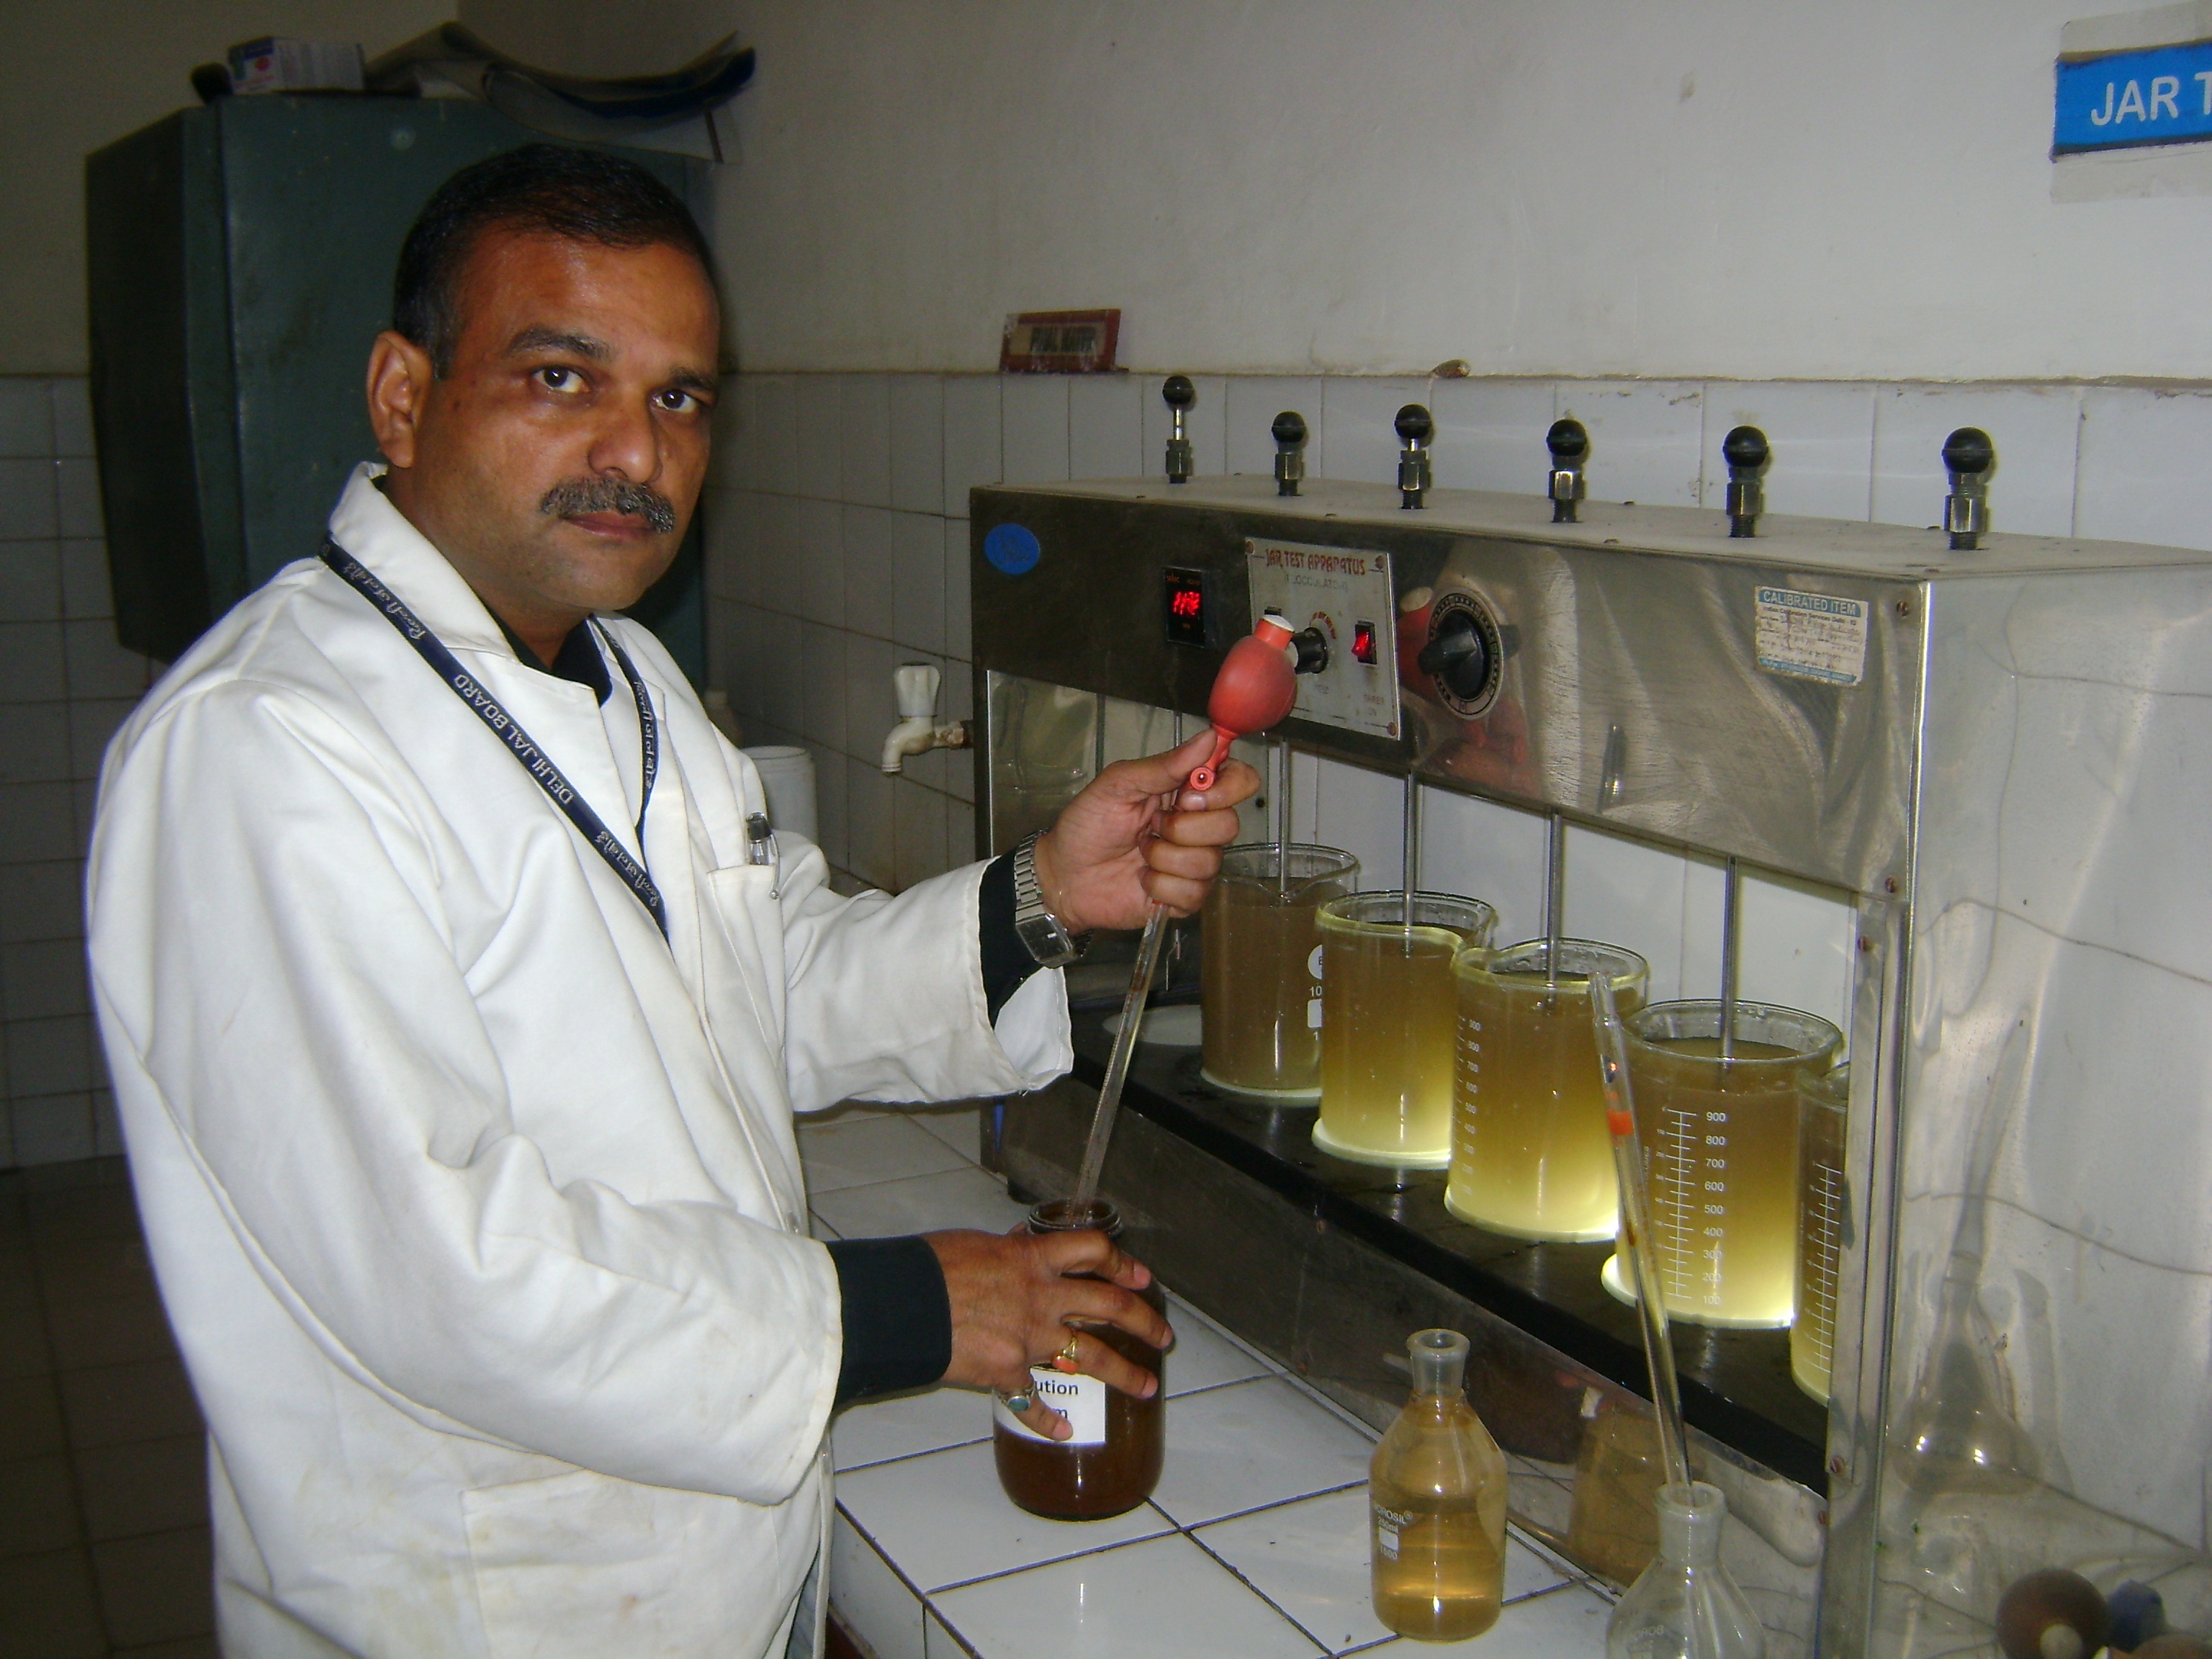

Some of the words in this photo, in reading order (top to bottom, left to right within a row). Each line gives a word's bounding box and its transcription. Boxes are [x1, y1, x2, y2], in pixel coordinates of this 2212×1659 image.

[2090, 76, 2180, 126] JAR
[1284, 550, 1305, 568] TEST
[1308, 554, 1365, 576] APPARATUS
[1763, 590, 1827, 611] CALIBRATED
[1831, 601, 1856, 616] ITEM
[454, 673, 510, 730] BOARD
[504, 724, 539, 760] JAL
[531, 757, 575, 805] DELHI
[1706, 1112, 1726, 1123] 900
[1705, 1135, 1725, 1146] 800
[1705, 1158, 1725, 1169] 700
[1704, 1181, 1724, 1192] 600
[1704, 1205, 1723, 1215] 500
[1703, 1227, 1723, 1237] 400
[1703, 1249, 1722, 1259] 300
[1702, 1272, 1721, 1282] 200
[1703, 1295, 1721, 1305] 100
